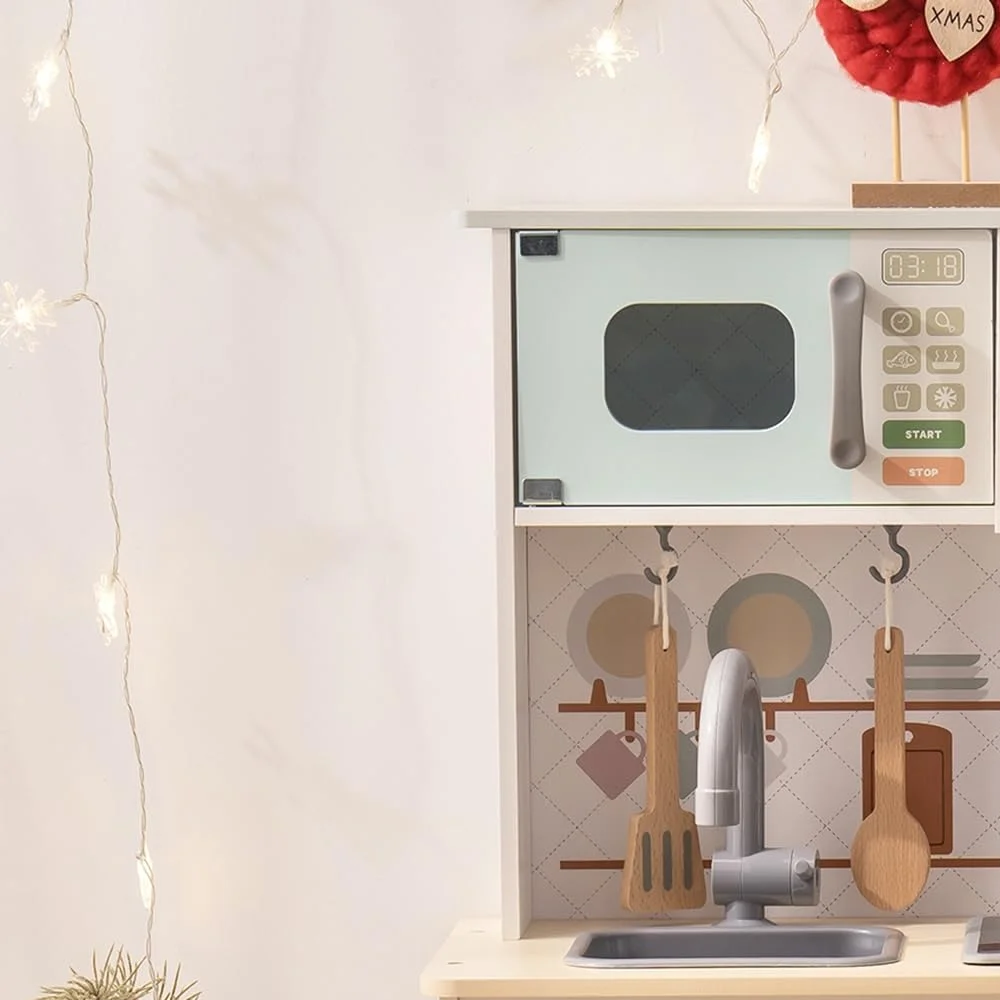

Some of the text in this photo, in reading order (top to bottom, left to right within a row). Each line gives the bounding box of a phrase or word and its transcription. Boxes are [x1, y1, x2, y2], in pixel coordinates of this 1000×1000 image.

[930, 6, 986, 33] XMAS
[889, 254, 957, 279] 03:18
[905, 430, 942, 439] START
[908, 468, 939, 477] STOP
